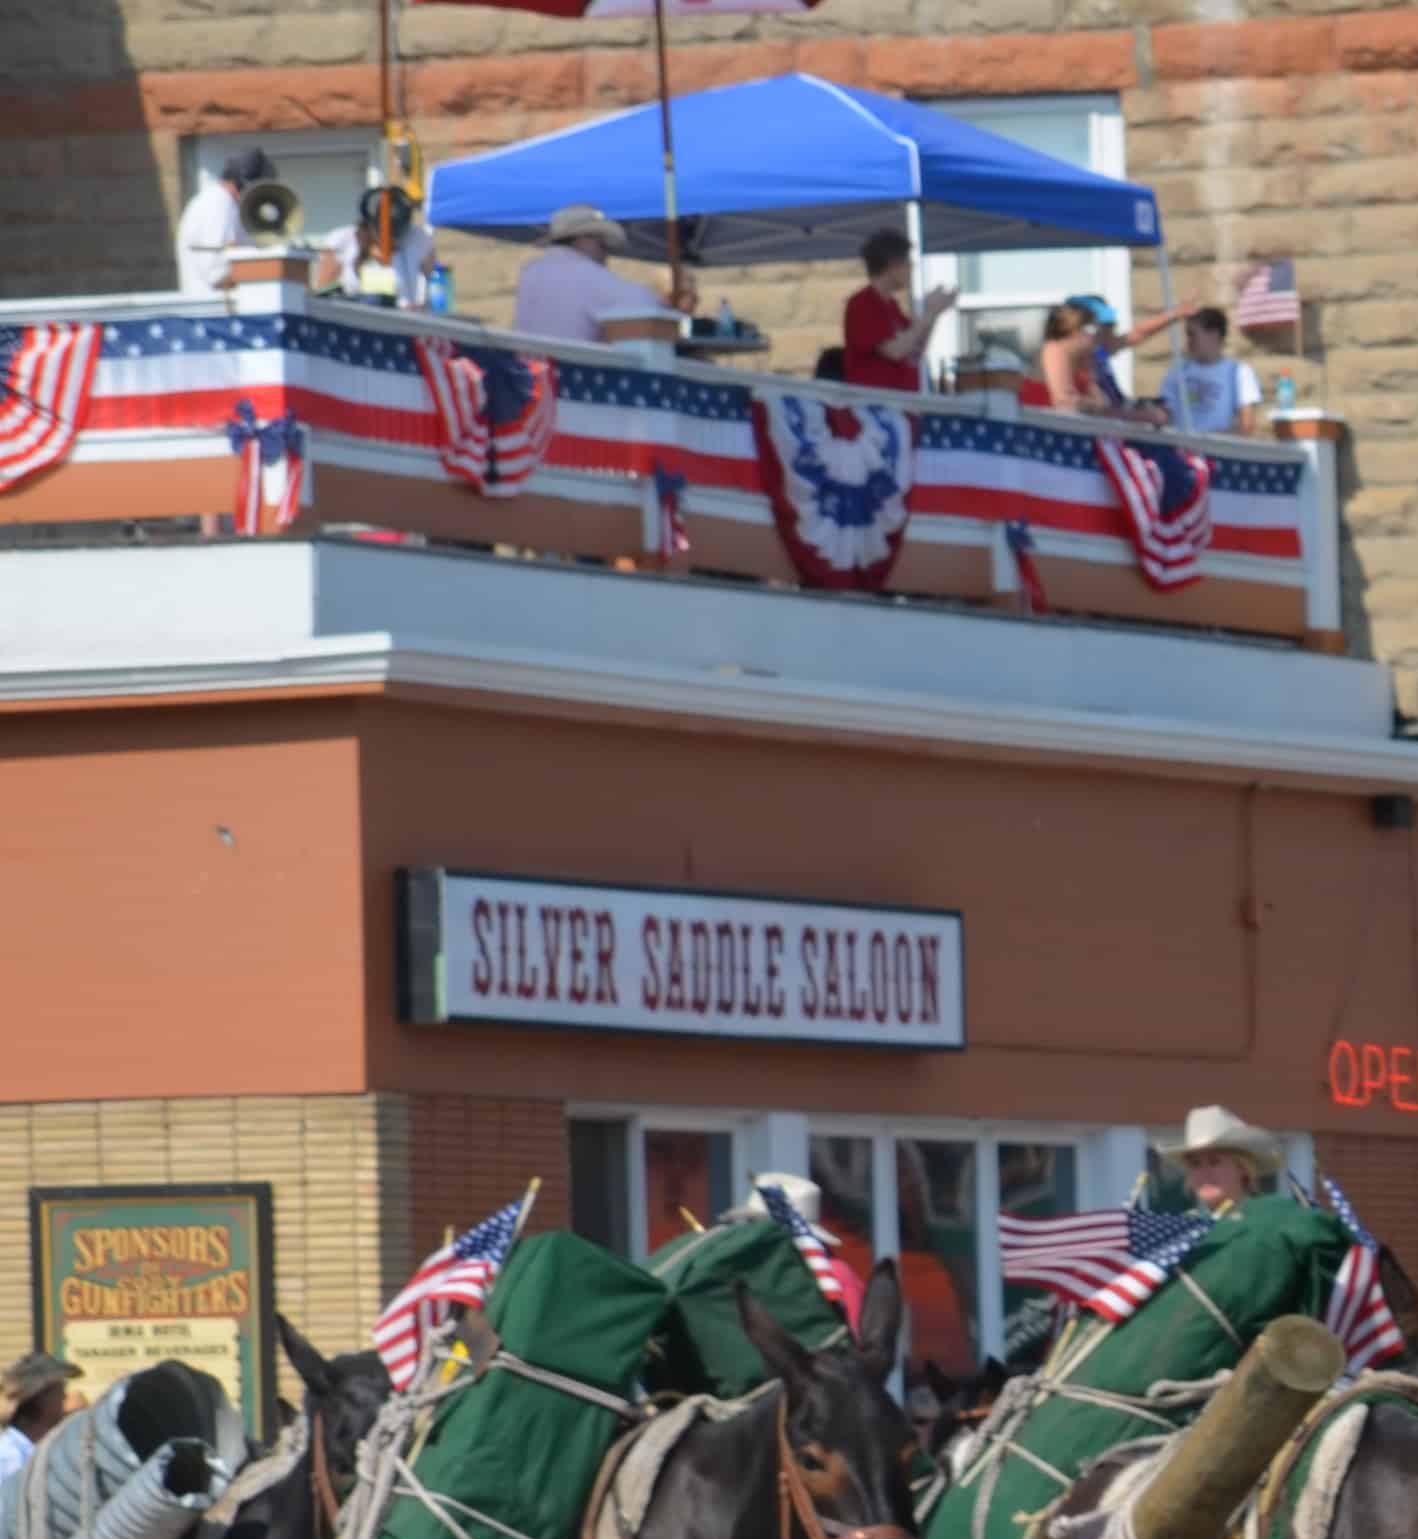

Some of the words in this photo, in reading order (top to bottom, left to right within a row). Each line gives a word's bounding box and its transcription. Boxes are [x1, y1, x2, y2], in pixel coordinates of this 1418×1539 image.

[472, 896, 618, 1005] SILVER
[641, 914, 786, 1018] SADDLE
[801, 926, 941, 1025] SALOON
[73, 1225, 230, 1274] SPONSORS
